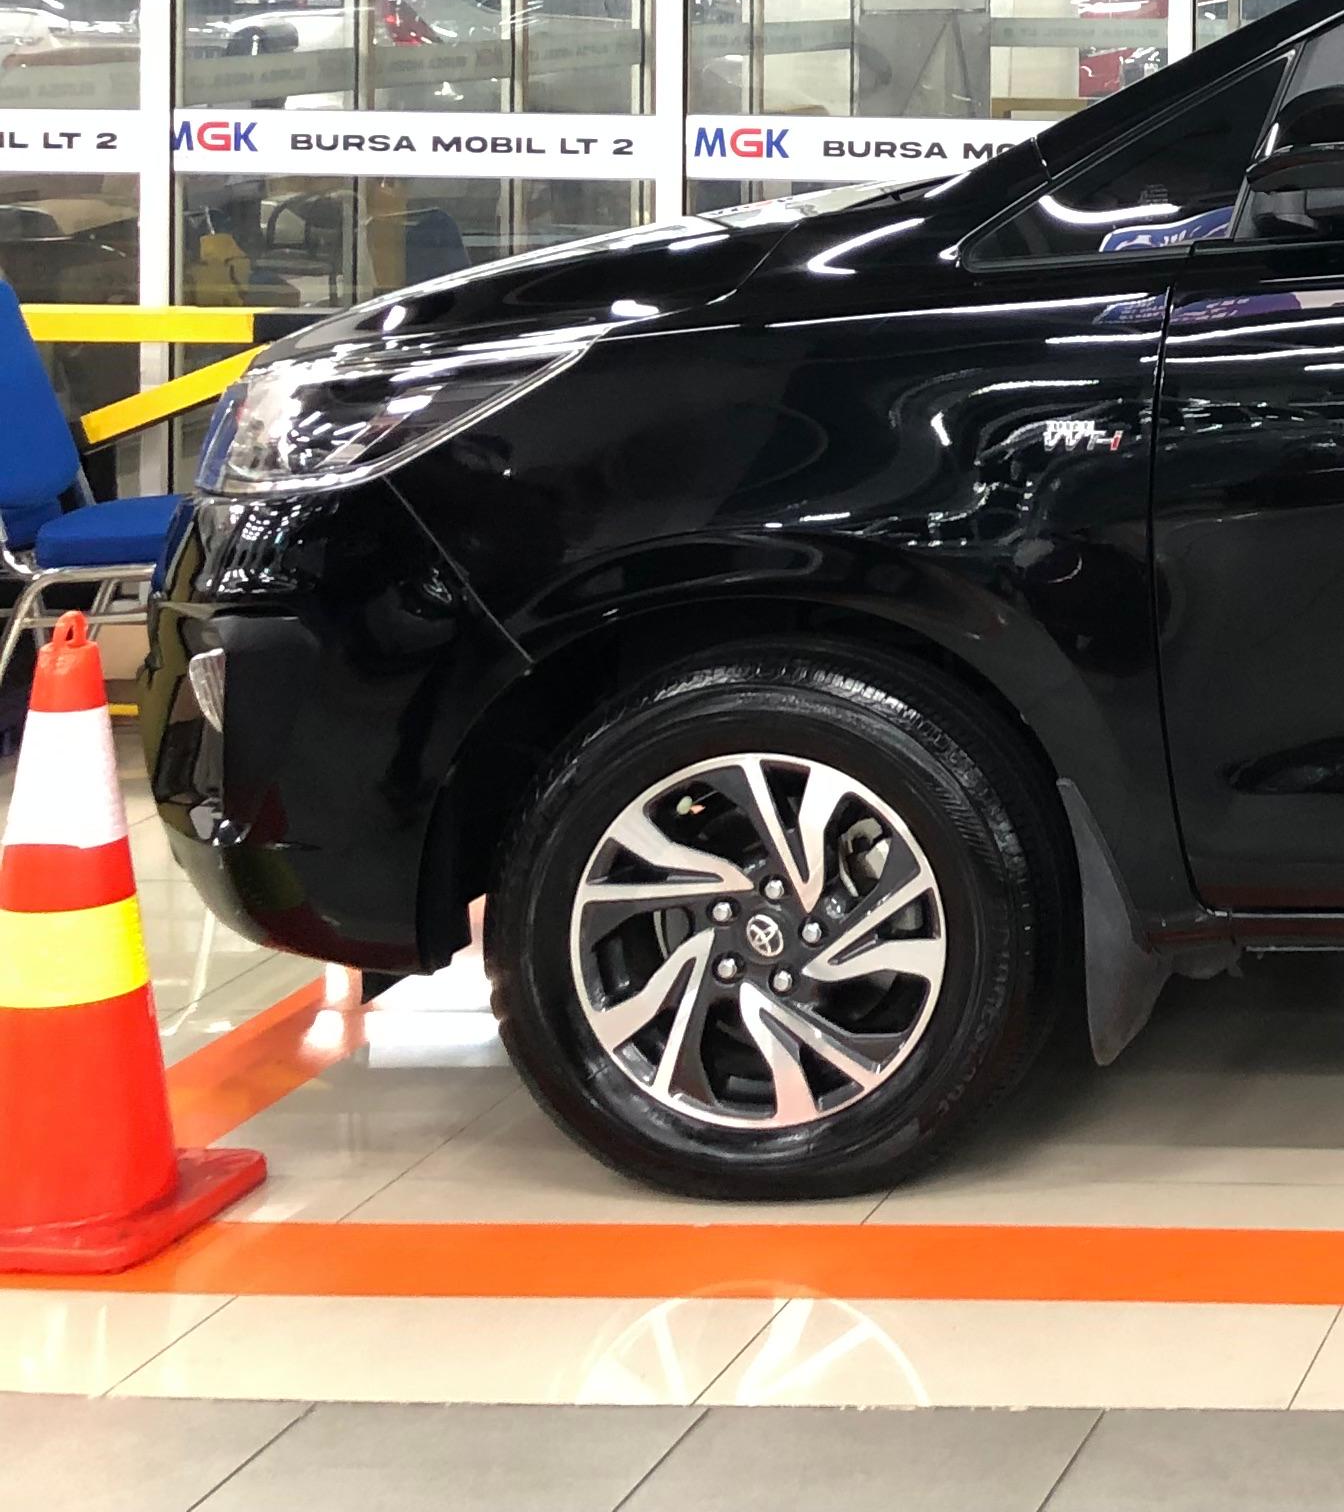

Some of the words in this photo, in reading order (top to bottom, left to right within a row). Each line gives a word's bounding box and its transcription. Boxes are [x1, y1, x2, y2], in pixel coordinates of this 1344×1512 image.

[43, 131, 82, 150] LT
[96, 132, 118, 150] 2
[173, 121, 259, 152] MGK
[290, 133, 417, 153] BURSA
[432, 135, 546, 155] MOBIL
[560, 137, 598, 155] LT
[612, 138, 634, 156] 2
[693, 126, 790, 159] MGK
[822, 139, 948, 159] BURSA
